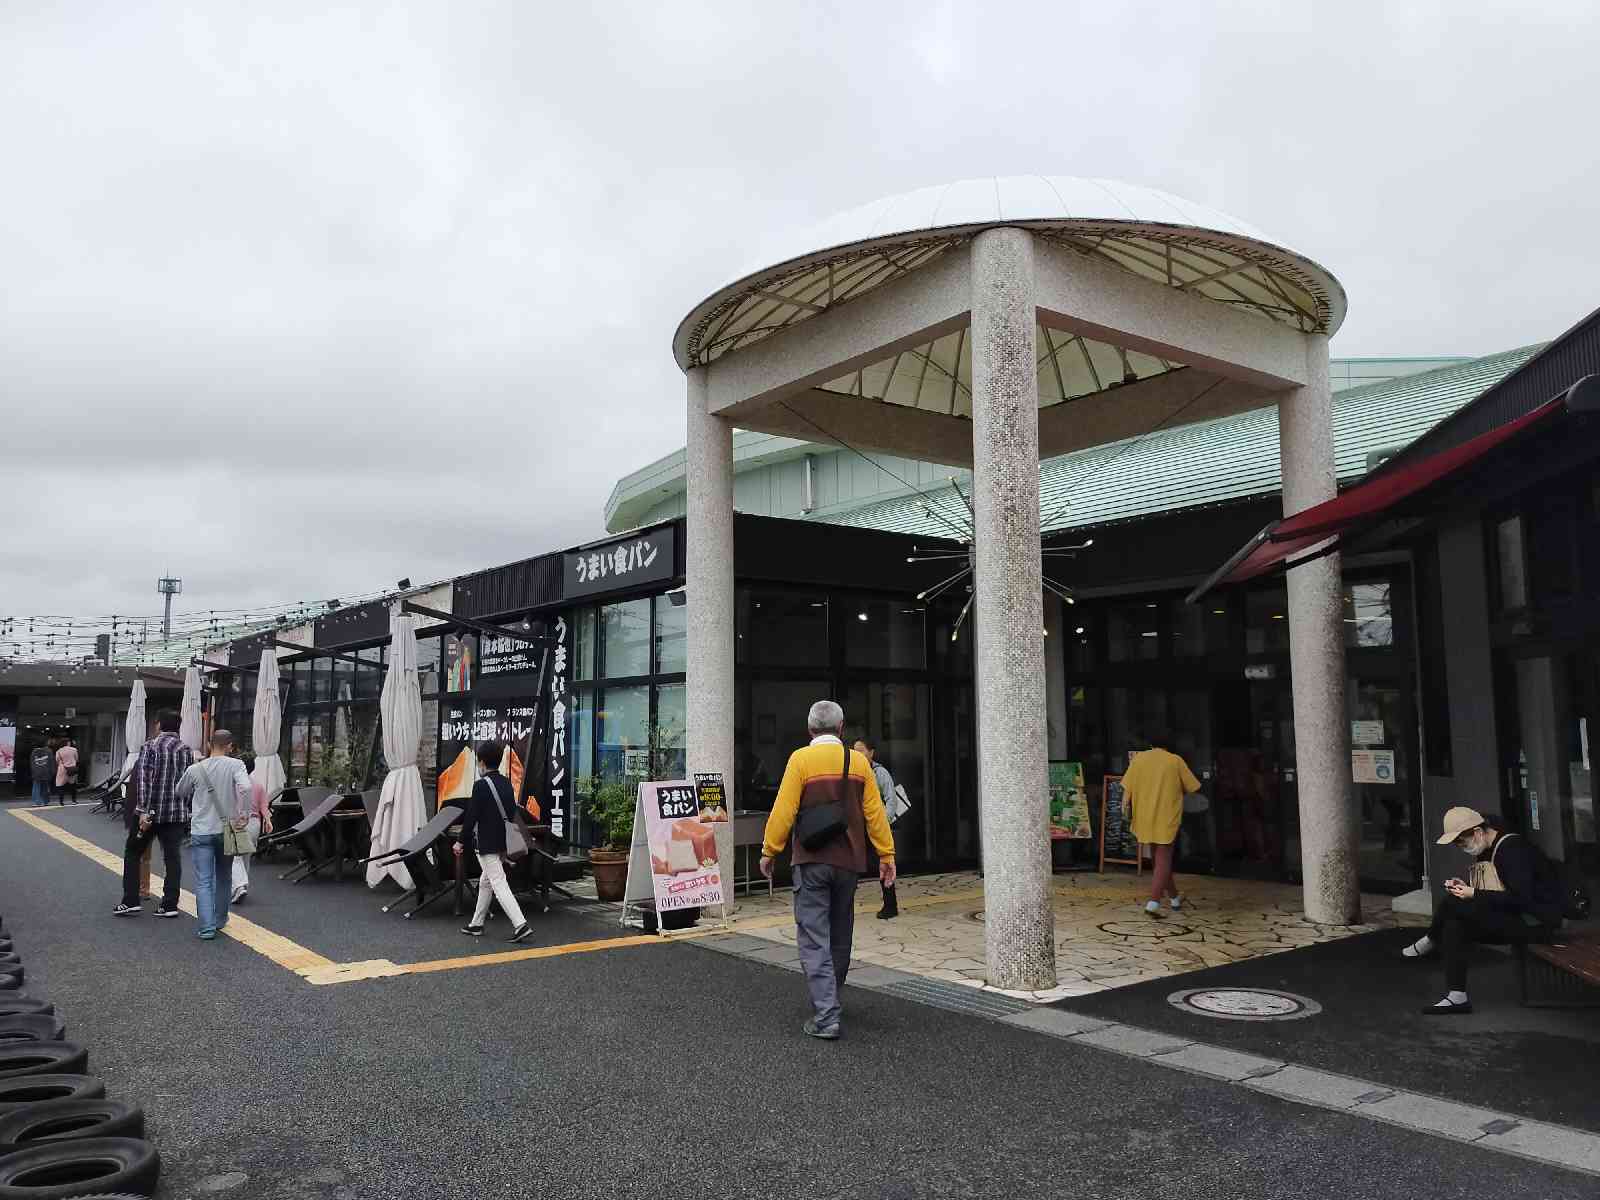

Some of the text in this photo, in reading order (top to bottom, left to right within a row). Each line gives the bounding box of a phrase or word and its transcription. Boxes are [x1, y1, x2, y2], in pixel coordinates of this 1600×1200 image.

[576, 541, 658, 583] うまい食パン
[661, 790, 692, 802] うまい
[662, 802, 694, 816] 食パン
[661, 896, 686, 908] OPEN
